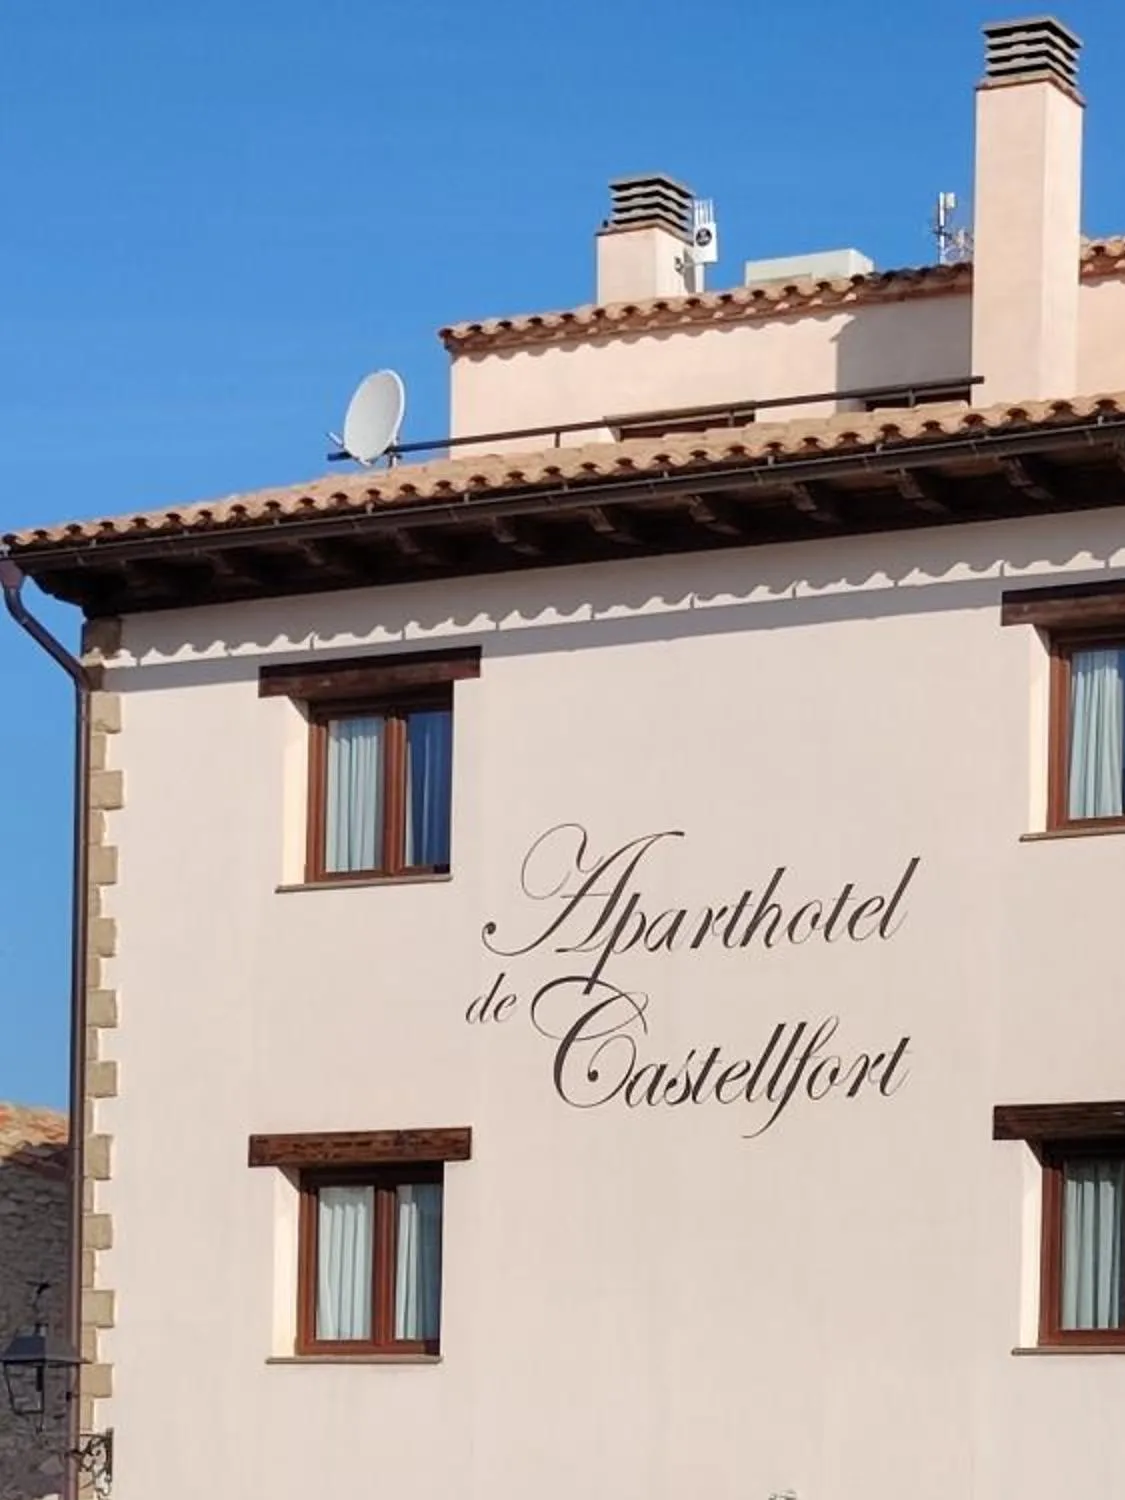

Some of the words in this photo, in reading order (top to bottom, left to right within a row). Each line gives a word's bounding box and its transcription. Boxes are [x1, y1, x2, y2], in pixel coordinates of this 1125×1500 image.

[481, 823, 921, 995] Aparthotel
[465, 972, 517, 1024] de
[530, 975, 911, 1139] Castellfort
